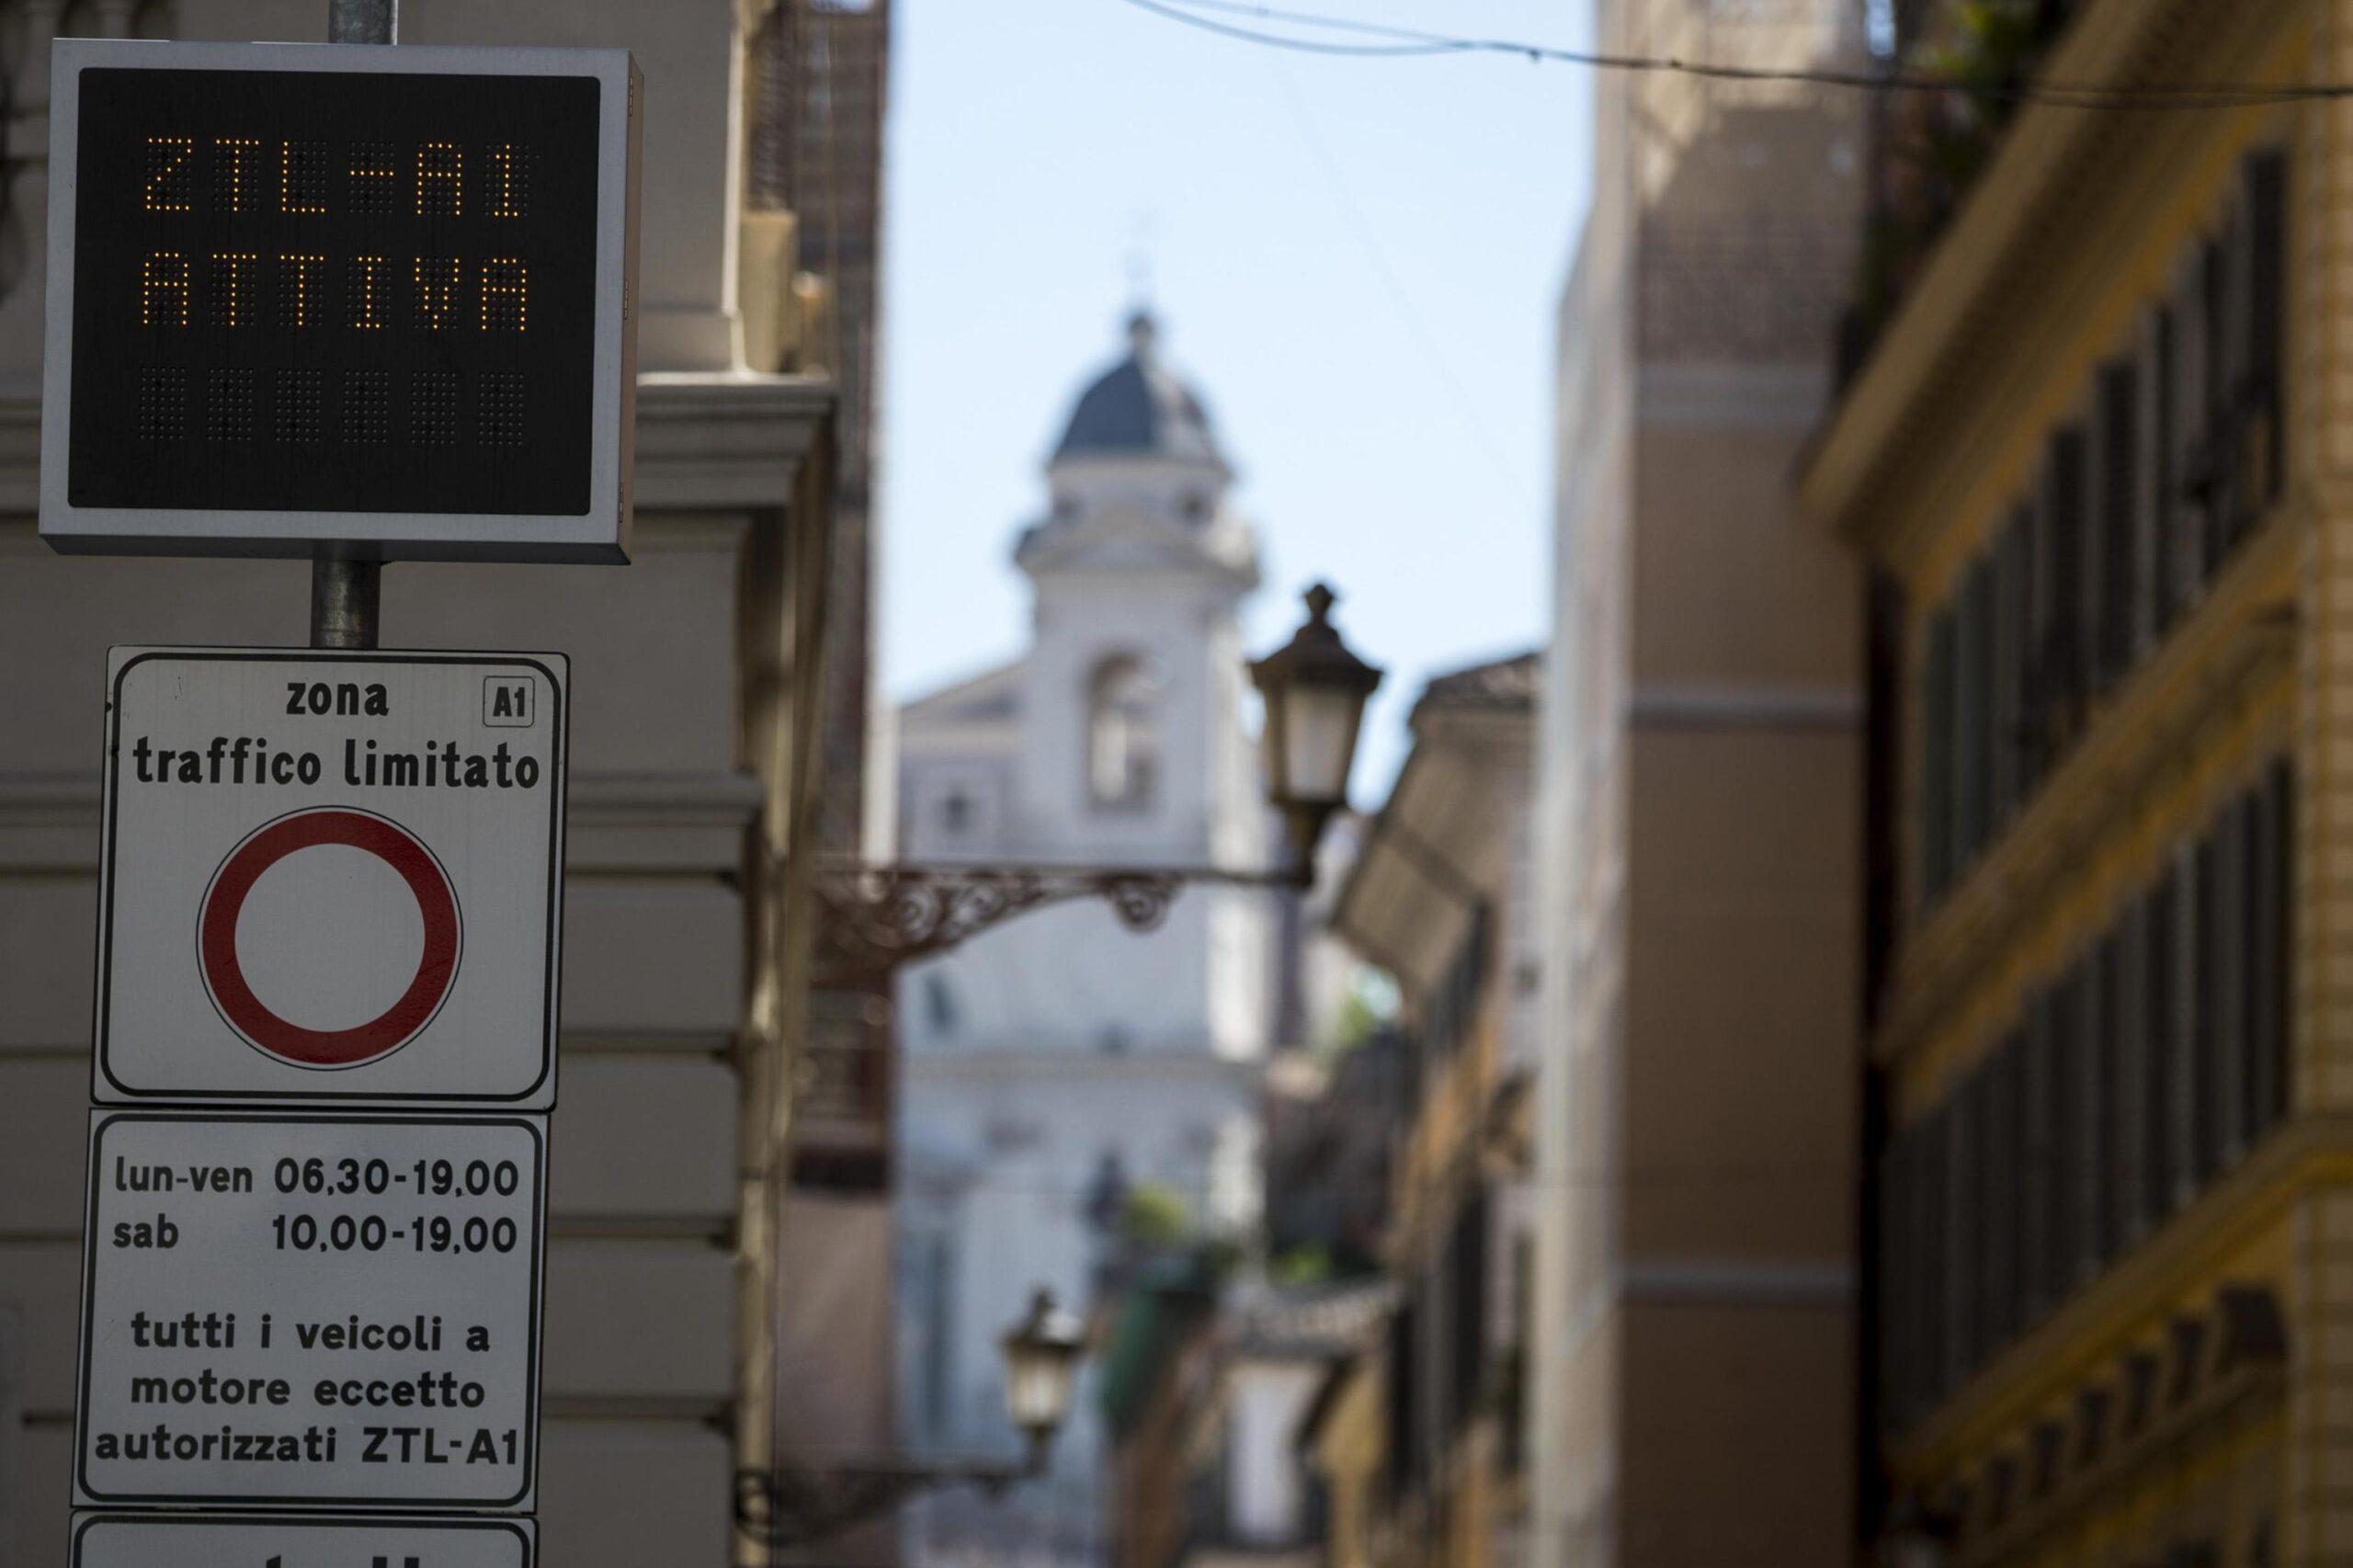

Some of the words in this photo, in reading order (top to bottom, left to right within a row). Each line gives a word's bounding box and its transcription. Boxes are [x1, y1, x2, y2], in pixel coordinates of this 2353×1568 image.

[145, 137, 519, 217] ZTL-A1
[142, 252, 528, 331] ATTIVA
[286, 682, 390, 717] zona
[492, 686, 526, 718] A1
[132, 735, 322, 786] traffico
[344, 738, 540, 790] limitato
[115, 1155, 253, 1193] lun-ven
[112, 1212, 179, 1249] sab
[130, 1311, 236, 1349] tutti
[260, 1312, 272, 1349] i
[295, 1314, 442, 1352] veicoli
[465, 1325, 491, 1353] a
[131, 1368, 290, 1406] motore
[313, 1370, 485, 1408] eccetto
[95, 1423, 337, 1463] autorizzati
[361, 1426, 517, 1465] ZTL-A1
